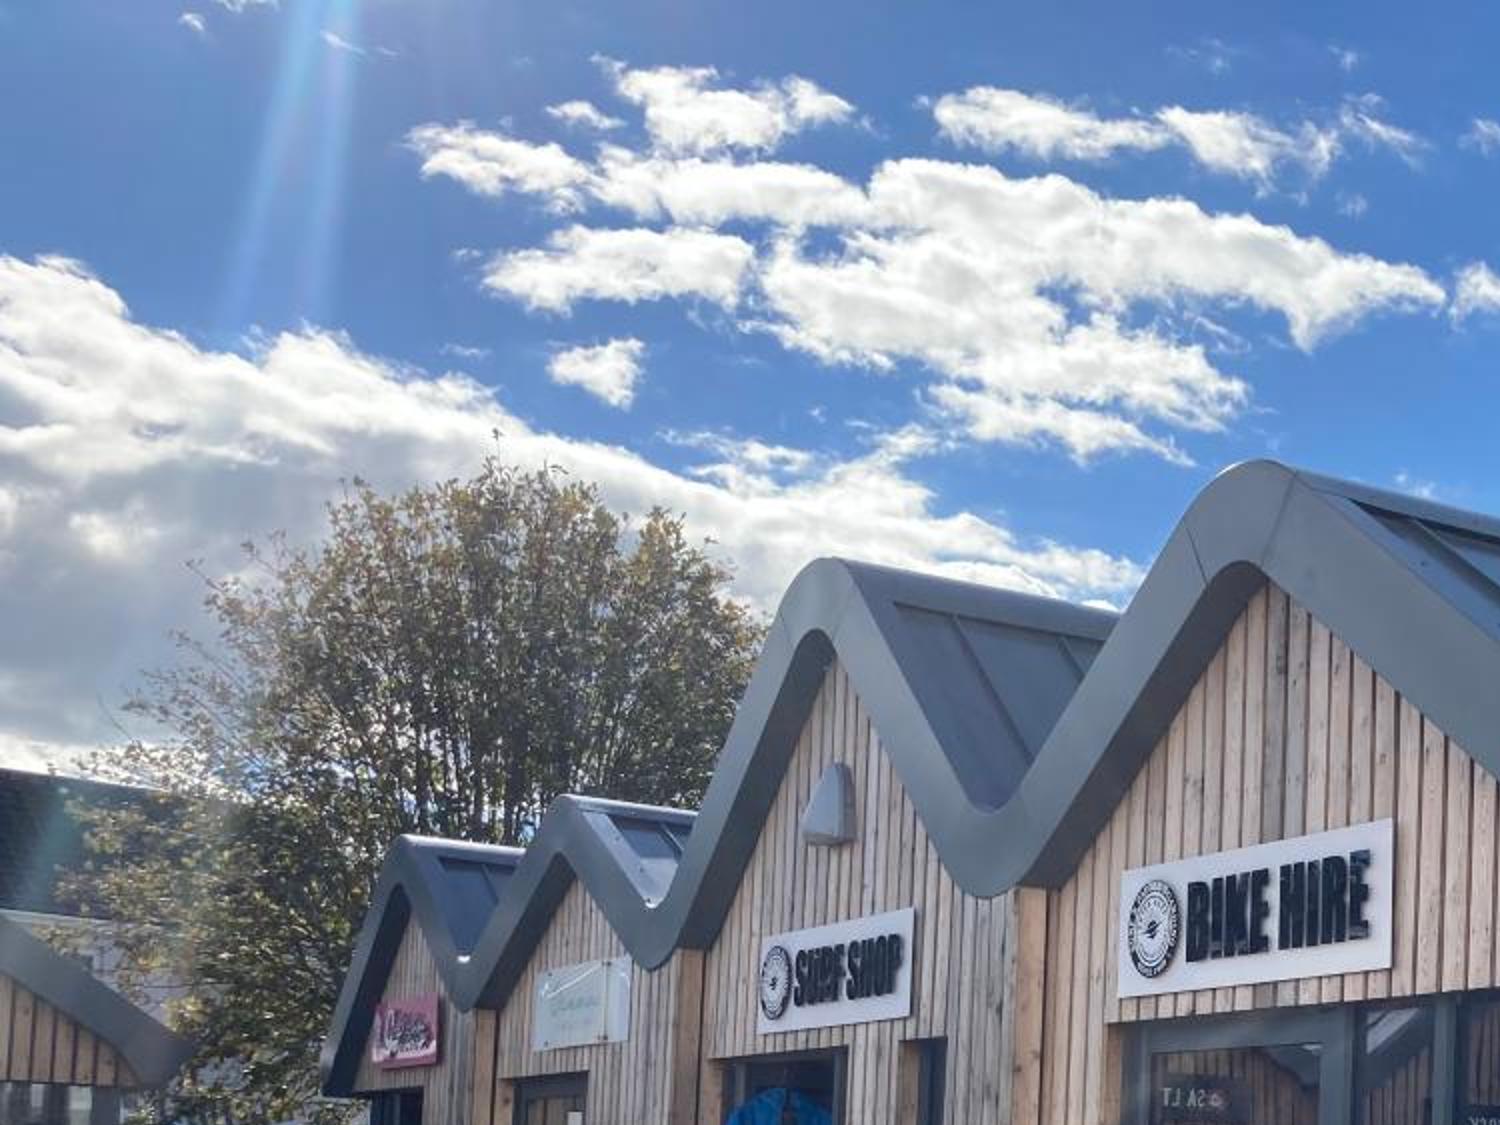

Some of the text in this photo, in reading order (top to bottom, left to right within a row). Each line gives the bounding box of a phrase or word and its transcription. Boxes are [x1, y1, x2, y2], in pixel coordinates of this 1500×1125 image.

[1185, 867, 1271, 963] BIKE
[1278, 849, 1372, 951] HIRE
[794, 943, 847, 1008] SURF
[846, 934, 904, 1001] SHOP
